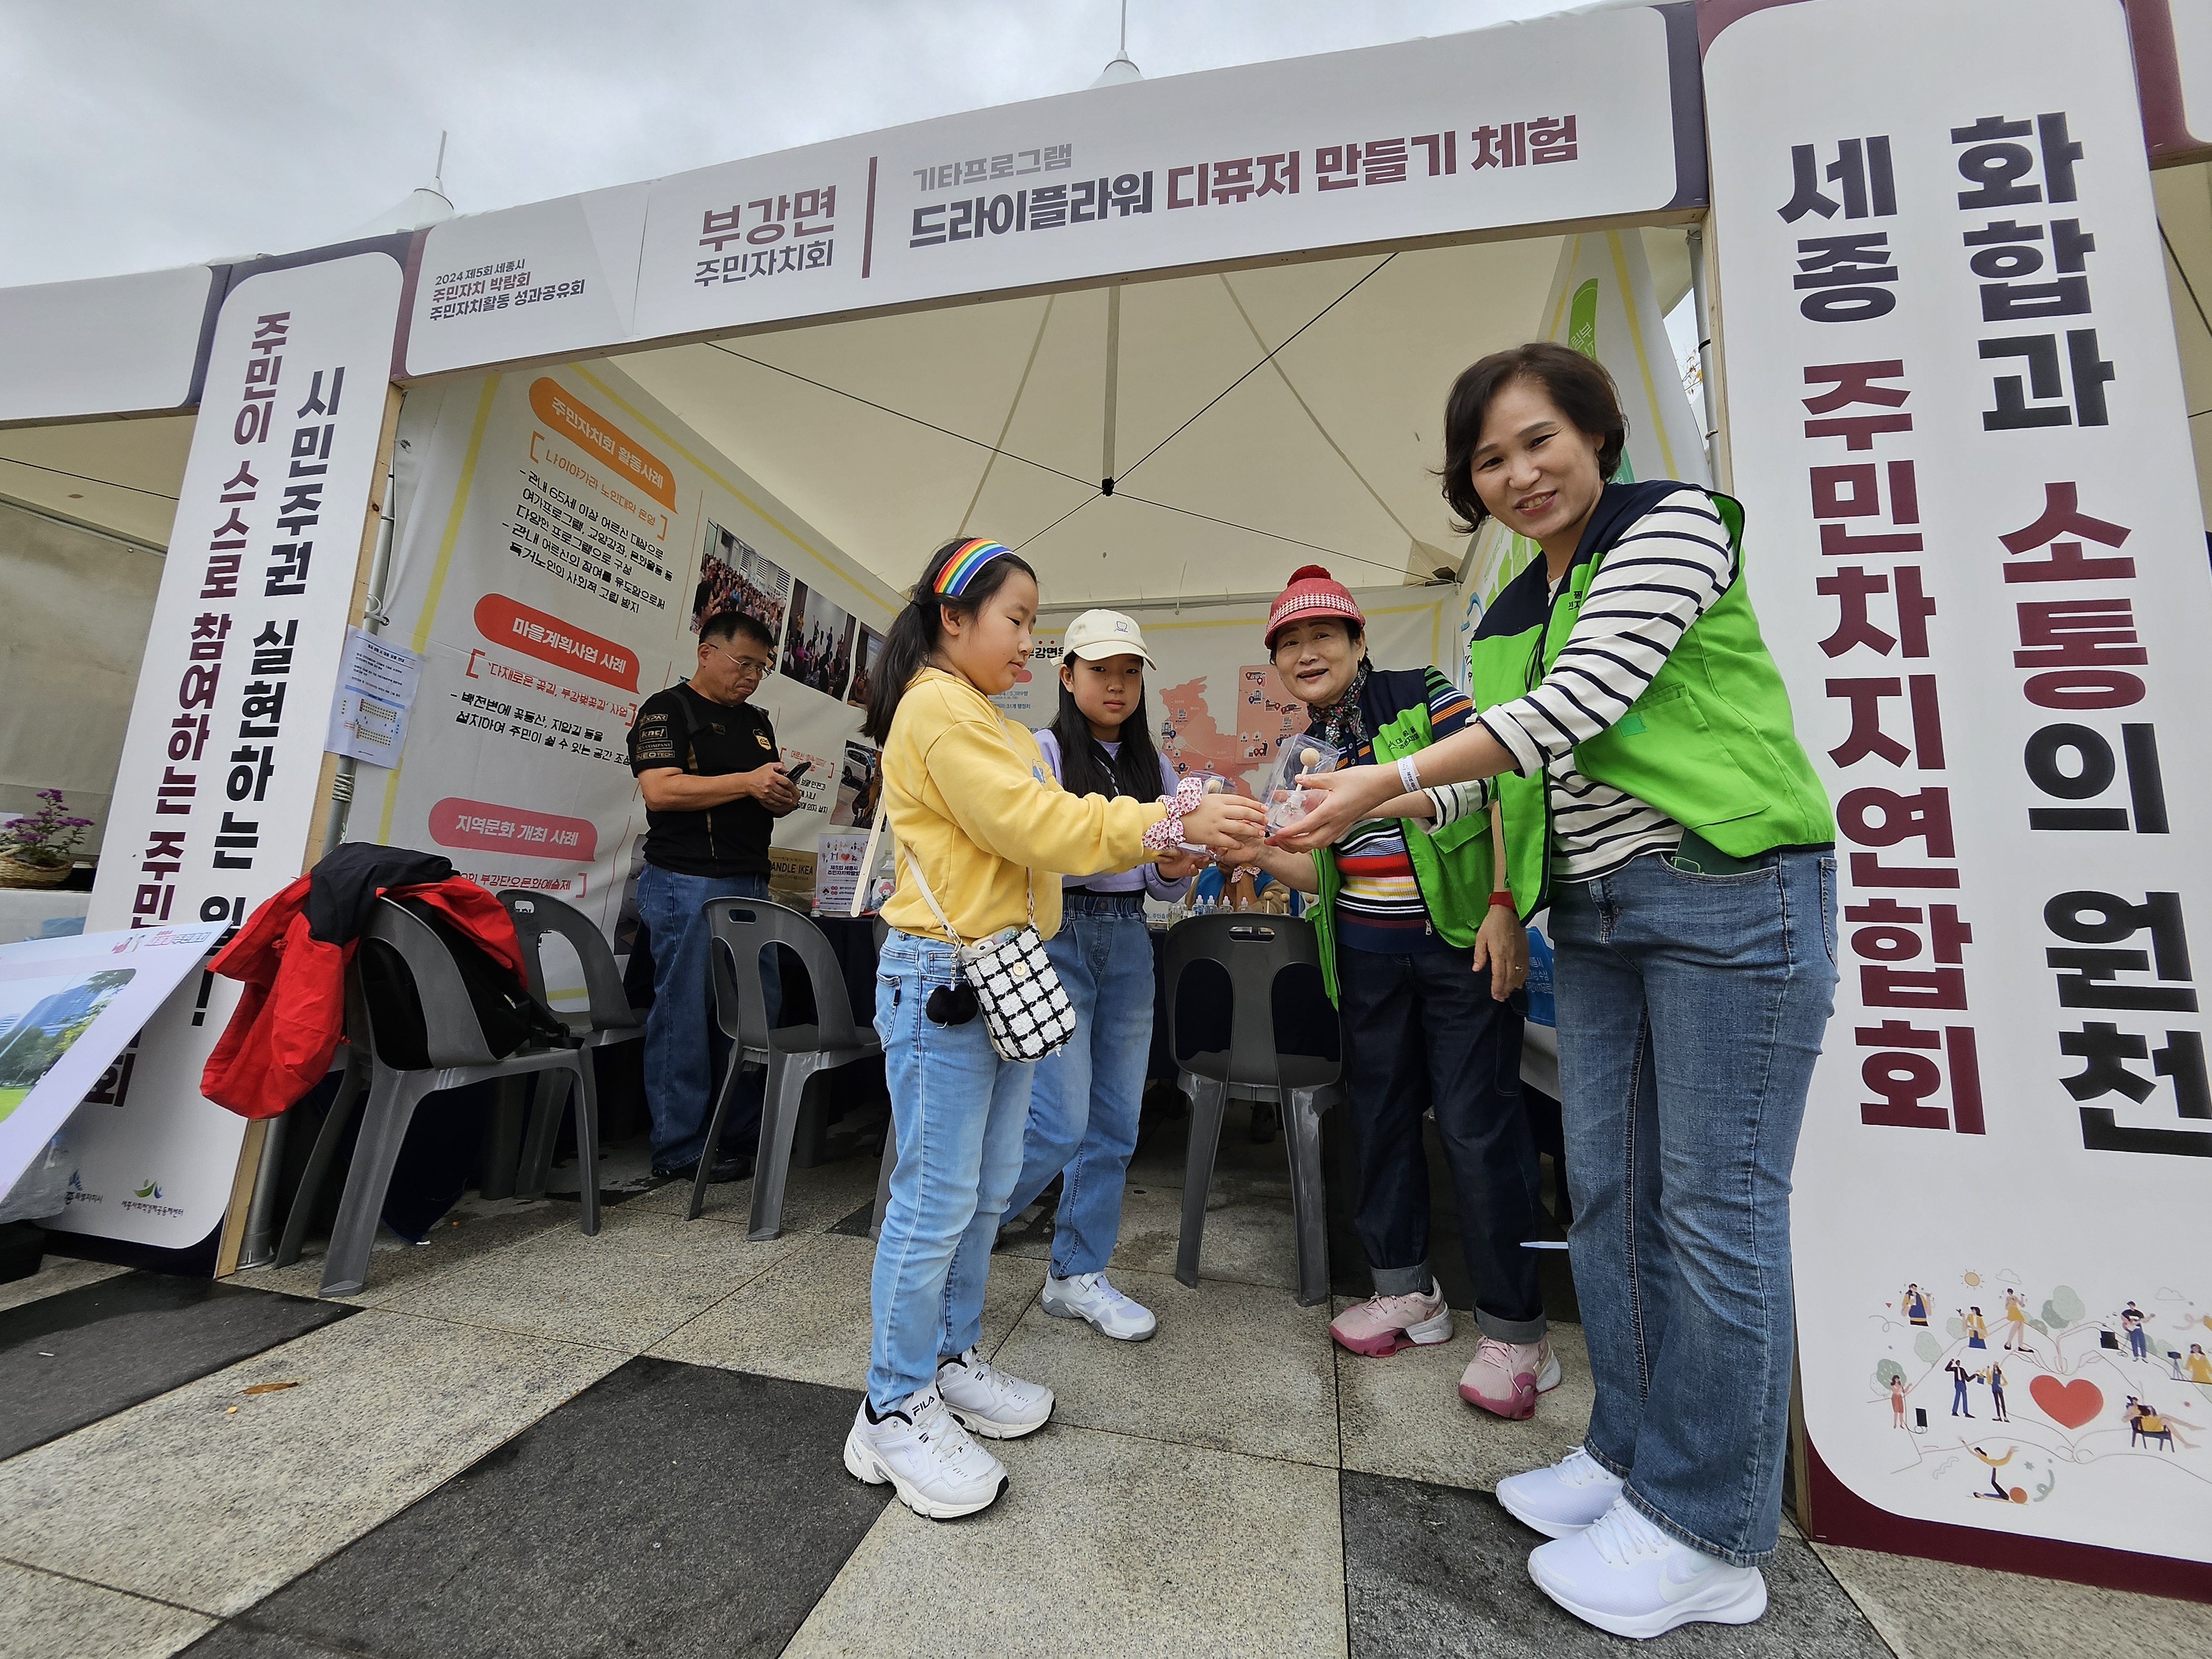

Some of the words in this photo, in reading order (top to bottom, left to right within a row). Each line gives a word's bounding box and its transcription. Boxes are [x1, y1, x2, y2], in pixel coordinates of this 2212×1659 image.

[909, 170, 1154, 249] 드라이플라워
[1166, 150, 1301, 210] 디퓨저
[1315, 133, 1457, 192] 만들기
[1470, 114, 1579, 173] 체험
[912, 143, 1073, 192] 기타프로그램
[699, 185, 836, 252] 부강면
[1776, 134, 1899, 324] 세종
[432, 280, 486, 303] 주민자치
[490, 272, 531, 292] 박람회
[435, 272, 463, 285] 2024
[465, 265, 493, 280] 제5회
[494, 259, 526, 274] 세종시
[694, 239, 834, 287] 주민자치회
[1950, 111, 2115, 431] 화합과
[430, 293, 510, 321] 주민자치활동
[514, 279, 585, 306] 성과공유회
[234, 311, 291, 445] 주민이
[552, 397, 615, 455] 주민자치회
[264, 366, 345, 597] 시민주권
[200, 460, 259, 599] 스스로
[516, 504, 550, 532] 다양한
[551, 524, 612, 565] 프로그램으로
[614, 559, 633, 576] 구성
[528, 471, 547, 493] 관내
[549, 487, 577, 510] 65세
[578, 504, 599, 522] 이상
[601, 517, 629, 540] 어르신
[630, 533, 664, 560] 대상으로
[509, 541, 565, 578] 독거노인의
[566, 571, 597, 593] 사회적
[599, 587, 619, 604] 고립
[621, 598, 639, 614] 방지
[512, 523, 538, 545] 관내
[541, 539, 580, 567] 어르신의
[582, 560, 612, 583] 참여를
[615, 577, 665, 611] 유도함으로써
[630, 550, 664, 576] 문화활동
[664, 570, 673, 582] 등
[512, 617, 598, 663] 마을계획사업
[600, 652, 627, 674] 사례
[1997, 481, 2169, 834] 소통의
[155, 612, 232, 815] 참여하는
[212, 619, 299, 869] 실현하는
[456, 711, 506, 734] 설치하여
[509, 725, 542, 744] 주민이
[558, 738, 568, 750] 수
[571, 742, 591, 756] 있는
[593, 747, 612, 761] 공간
[461, 691, 511, 717] 백천변에
[551, 718, 583, 736] 지압길
[584, 728, 603, 743] 등을
[609, 704, 628, 718] 사업
[455, 814, 515, 838] 지역문화
[517, 825, 547, 842] 개최
[549, 830, 579, 847] 사례
[770, 862, 796, 873] ANDLE
[799, 865, 813, 875] IKEA
[2043, 890, 2212, 1158] 원천
[912, 1395, 935, 1417] FILA
